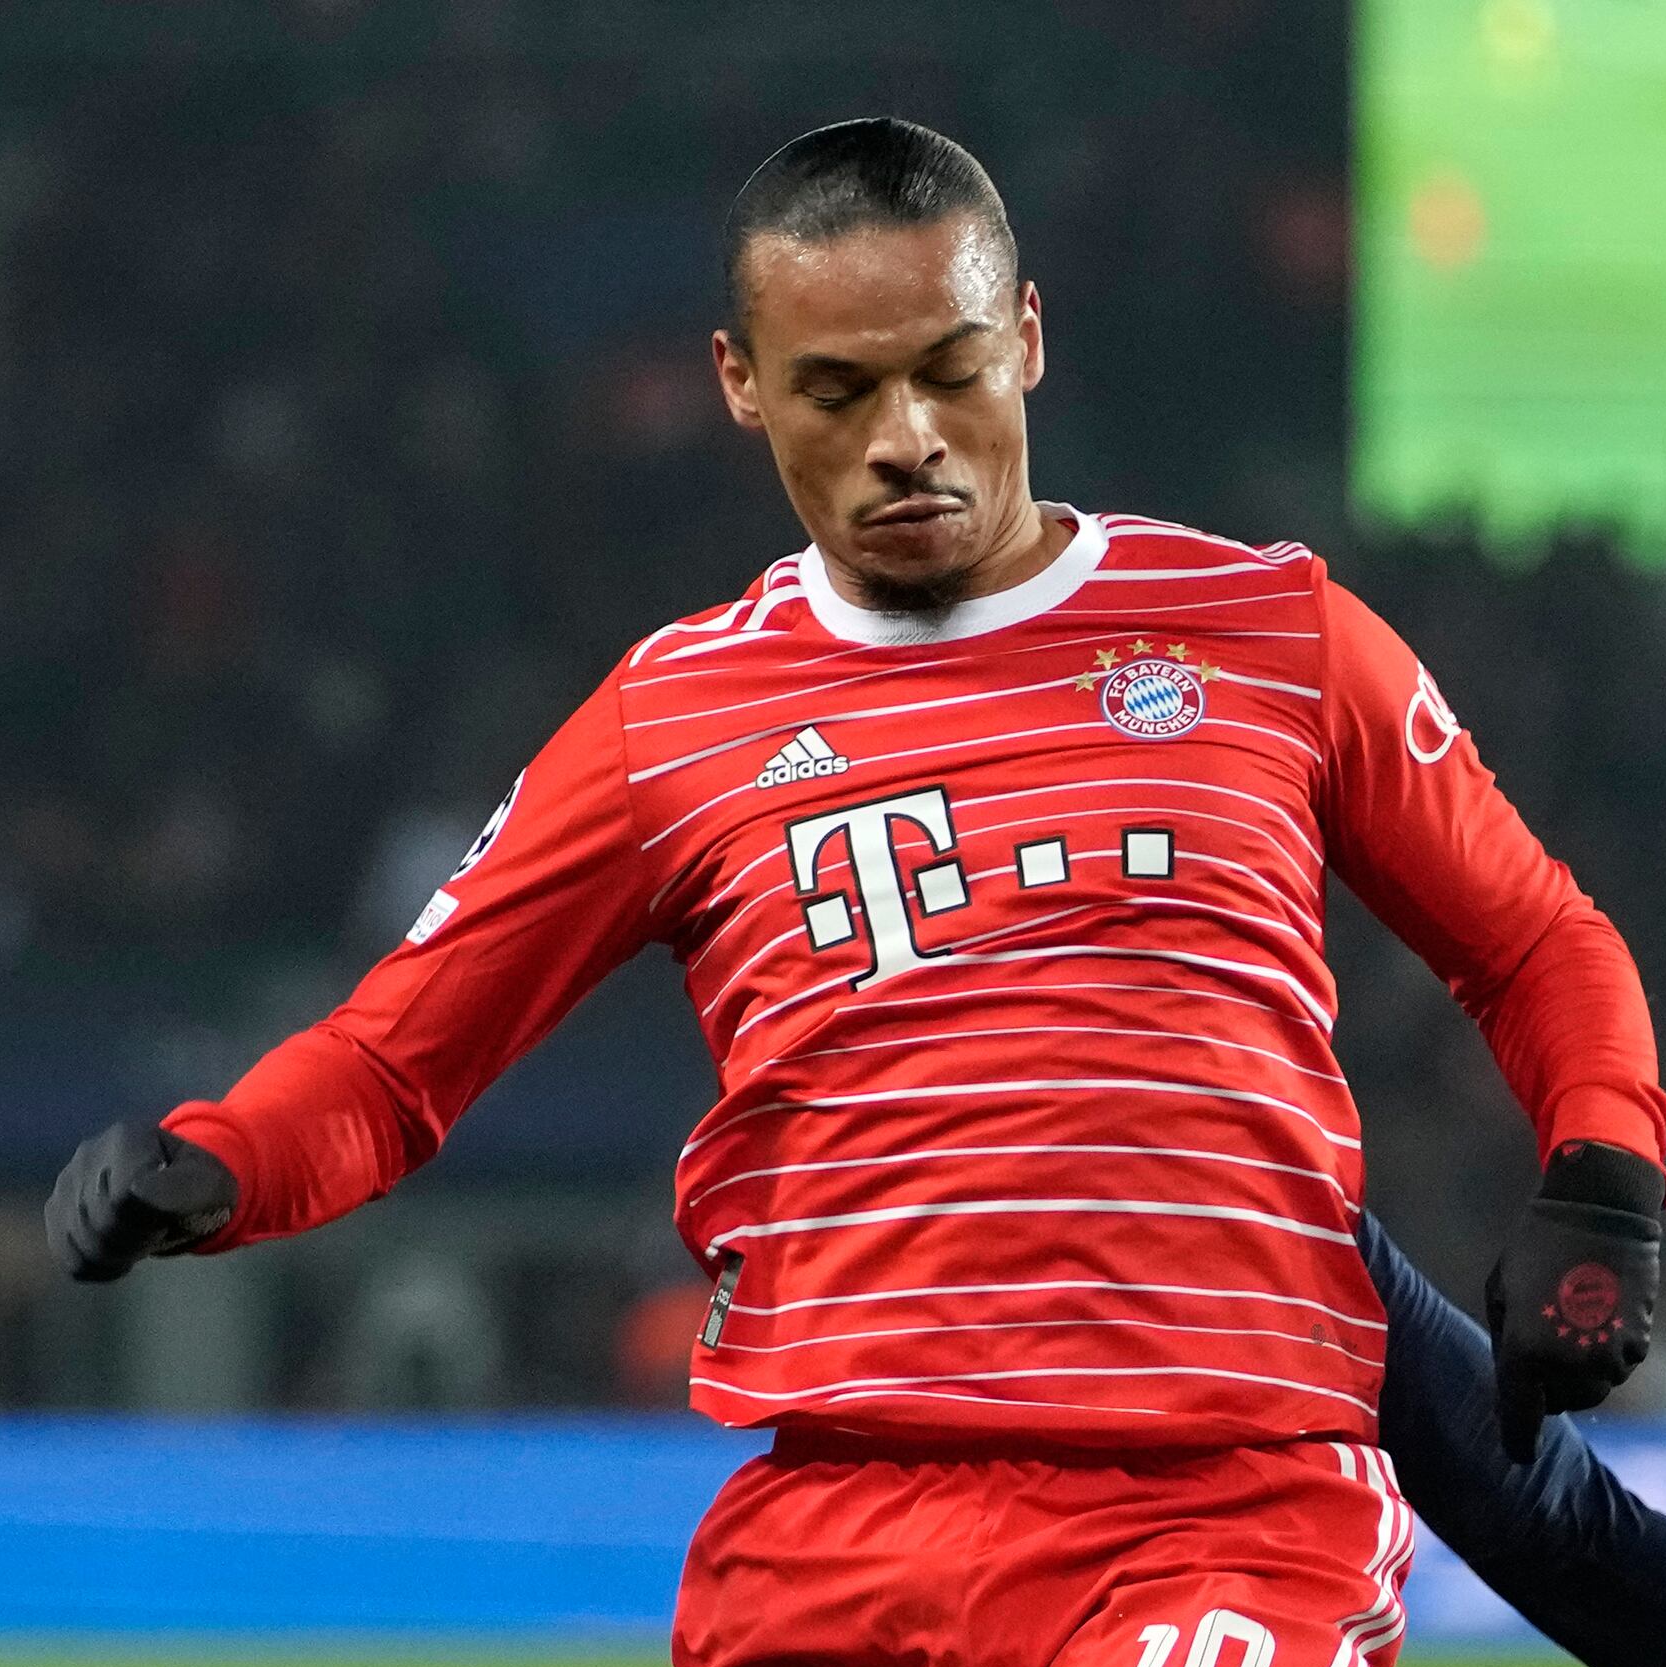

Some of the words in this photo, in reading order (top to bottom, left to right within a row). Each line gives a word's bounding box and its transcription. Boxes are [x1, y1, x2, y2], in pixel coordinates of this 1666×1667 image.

[1109, 677, 1127, 698] FC
[1125, 664, 1194, 692] BAYERN
[1114, 704, 1197, 734] MÜNCHEN
[755, 755, 850, 790] adidas
[785, 783, 959, 993] T
